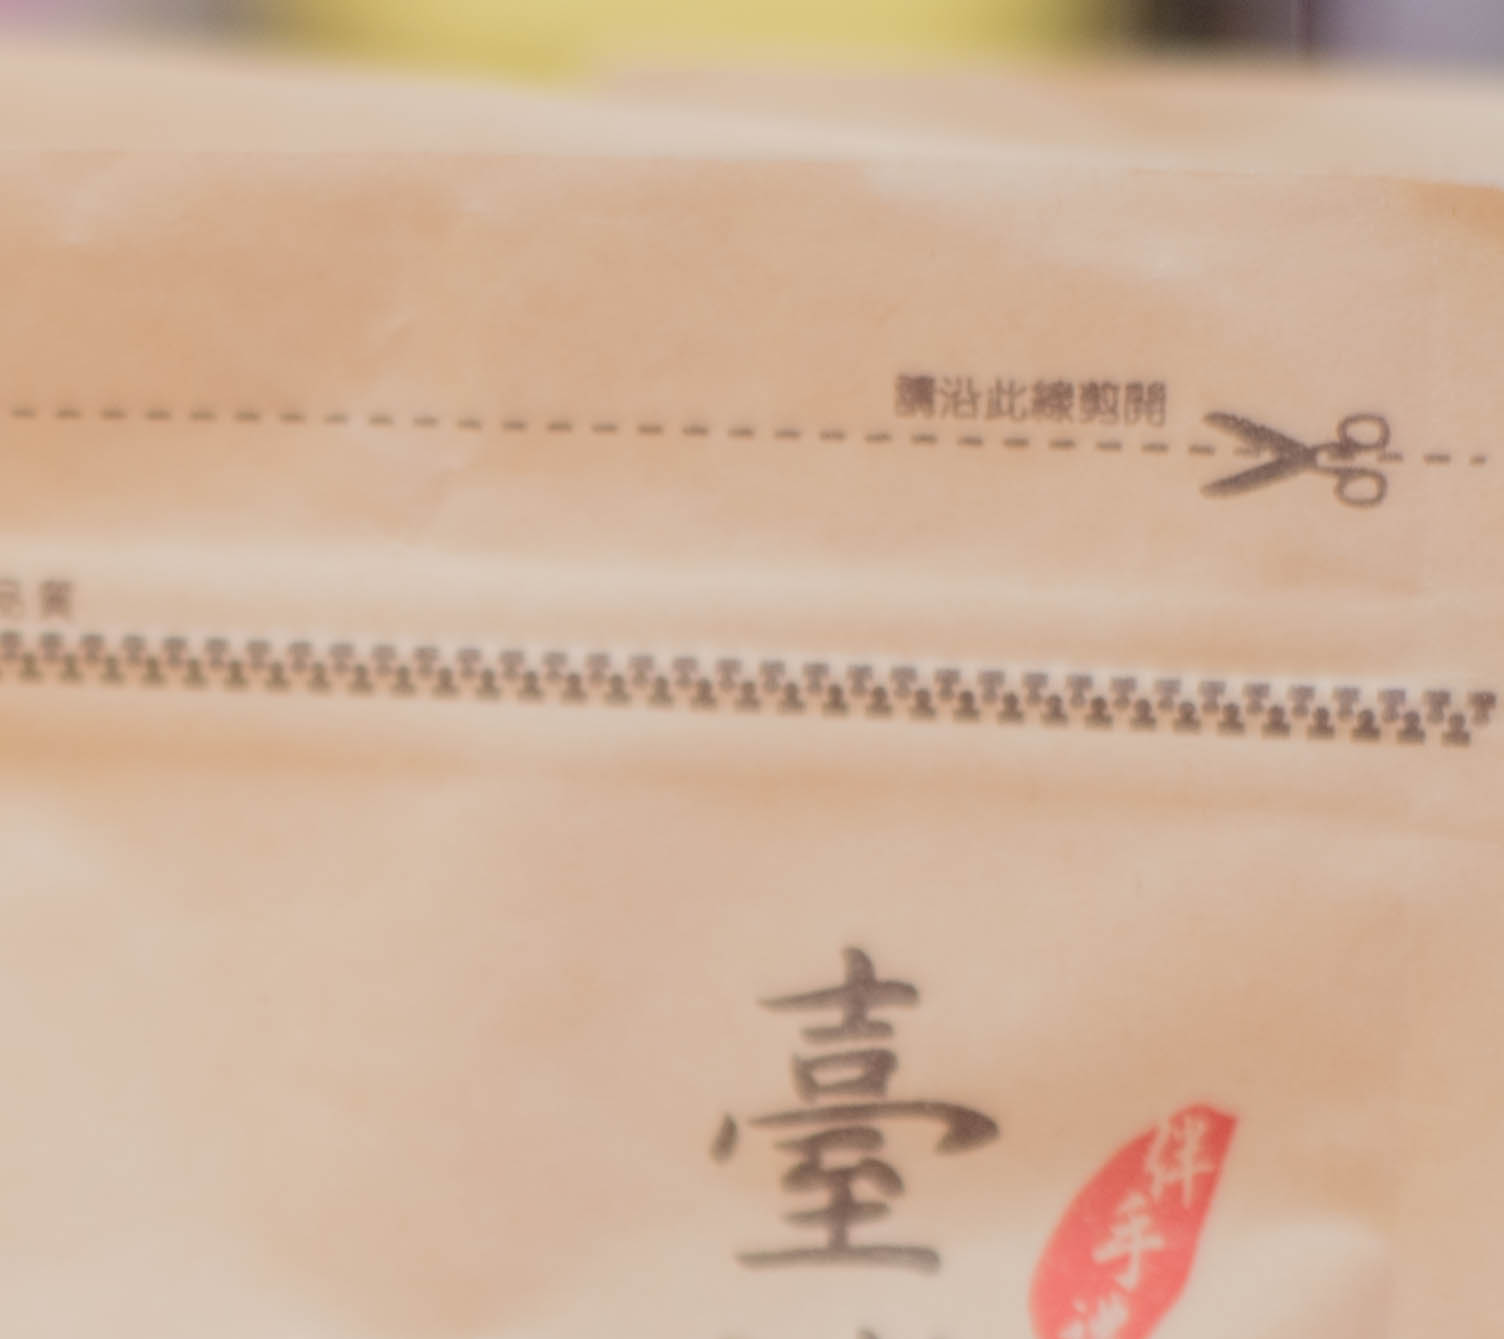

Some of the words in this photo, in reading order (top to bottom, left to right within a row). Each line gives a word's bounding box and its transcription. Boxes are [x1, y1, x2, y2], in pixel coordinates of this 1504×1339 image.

[894, 375, 1166, 426] 請沿此線剪開
